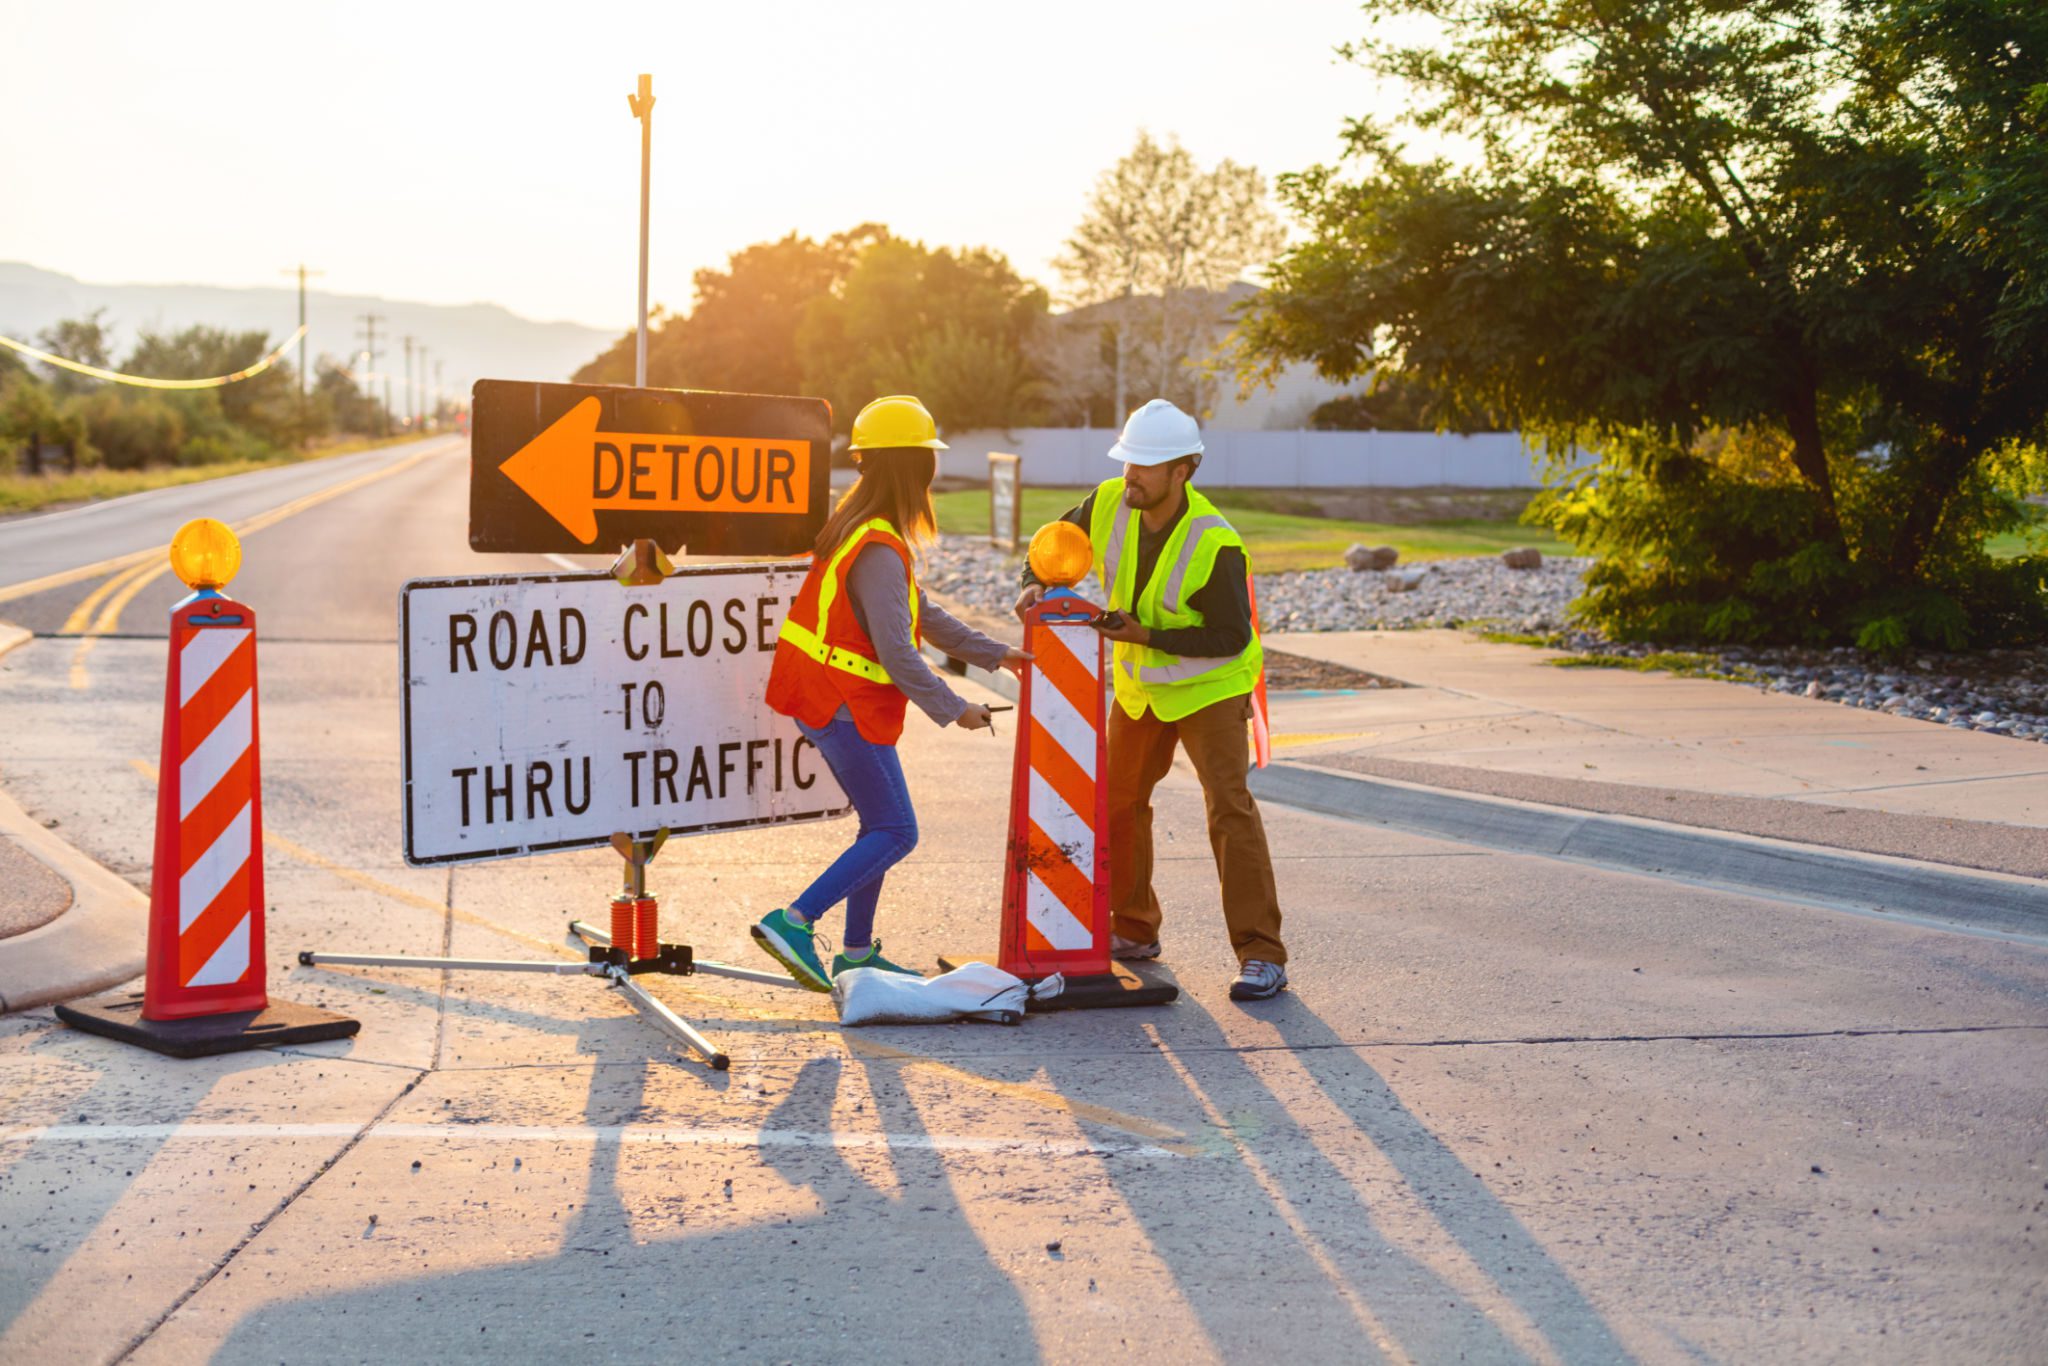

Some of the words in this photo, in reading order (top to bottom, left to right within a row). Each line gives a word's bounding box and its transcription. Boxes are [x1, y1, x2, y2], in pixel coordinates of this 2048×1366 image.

[594, 442, 796, 504] DETOUR
[449, 607, 588, 673] ROAD
[623, 596, 796, 661] CLOSE
[620, 680, 666, 730] TO
[452, 756, 591, 827] THRU
[623, 737, 817, 807] TRAFFIC
